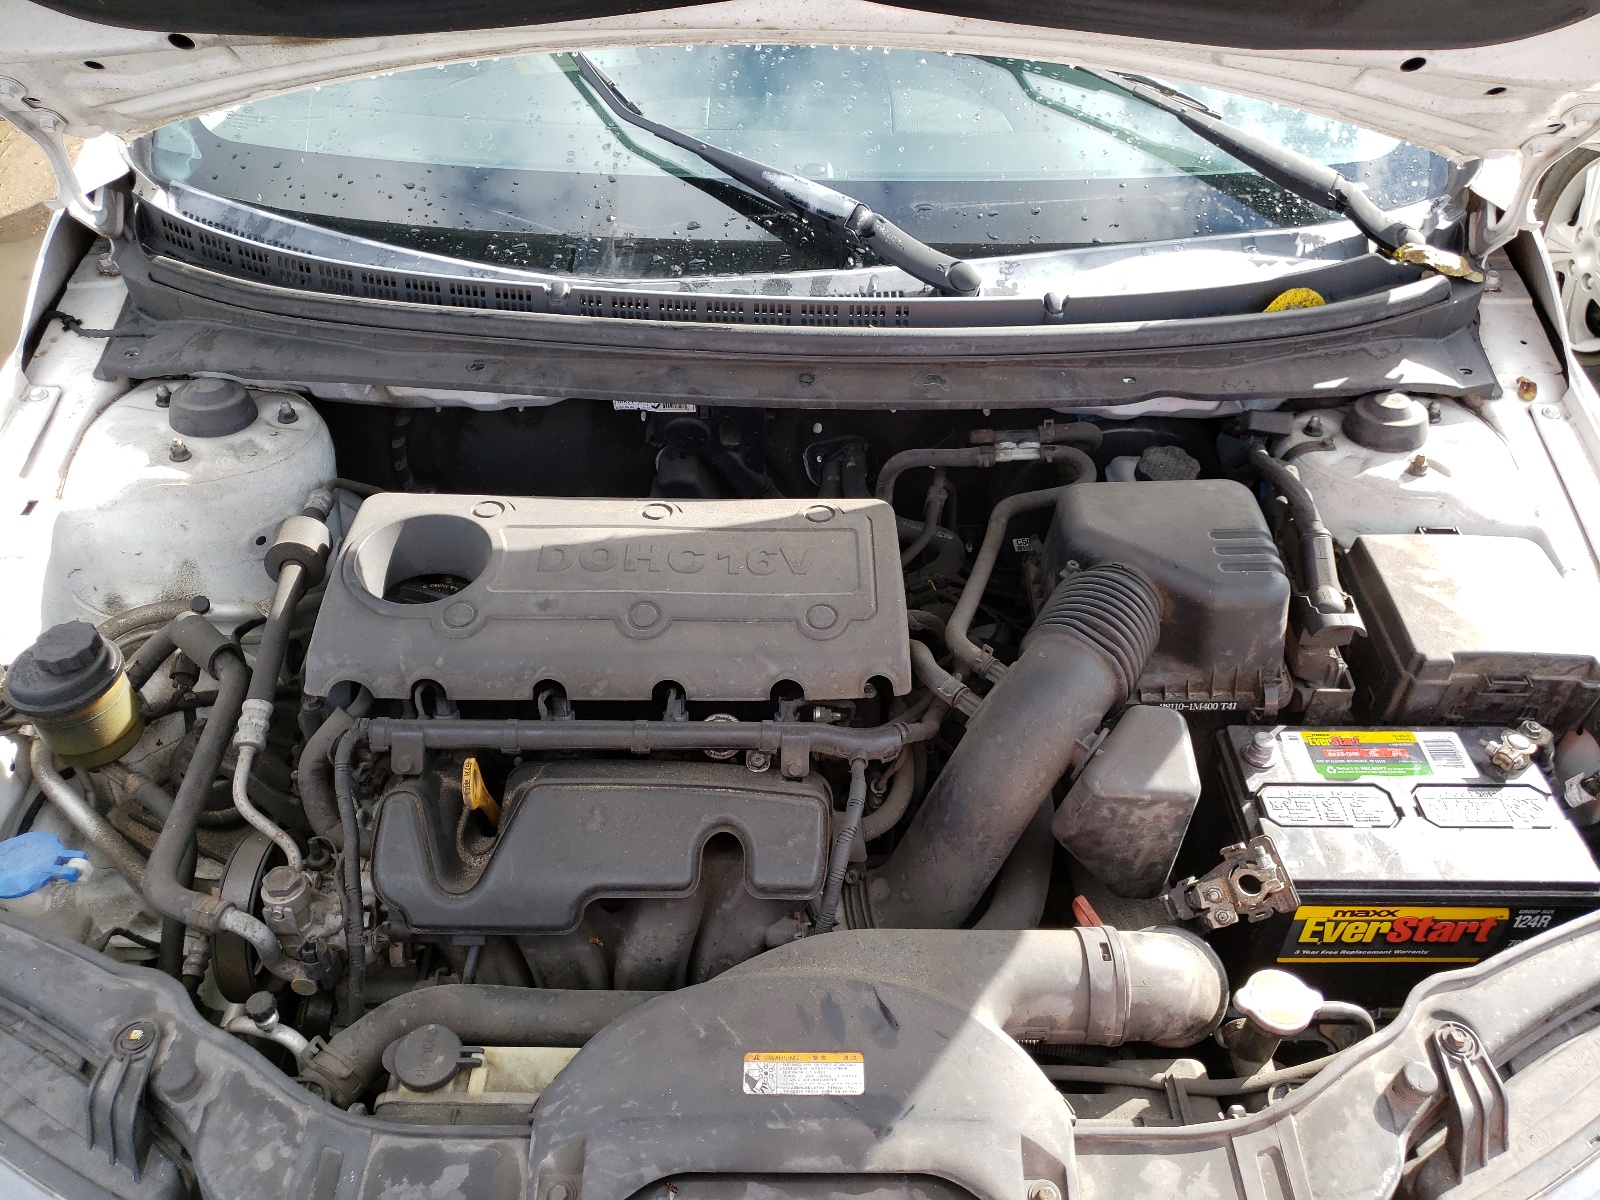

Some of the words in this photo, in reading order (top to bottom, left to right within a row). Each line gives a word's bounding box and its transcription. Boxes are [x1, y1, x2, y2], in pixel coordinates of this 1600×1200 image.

[536, 544, 706, 575] DOHC
[717, 547, 813, 576] 16V
[1220, 702, 1237, 710] T41
[1306, 736, 1361, 746] EverStart
[1333, 909, 1401, 918] maxx
[1513, 915, 1552, 928] 124R
[1298, 916, 1498, 943] EverStart
